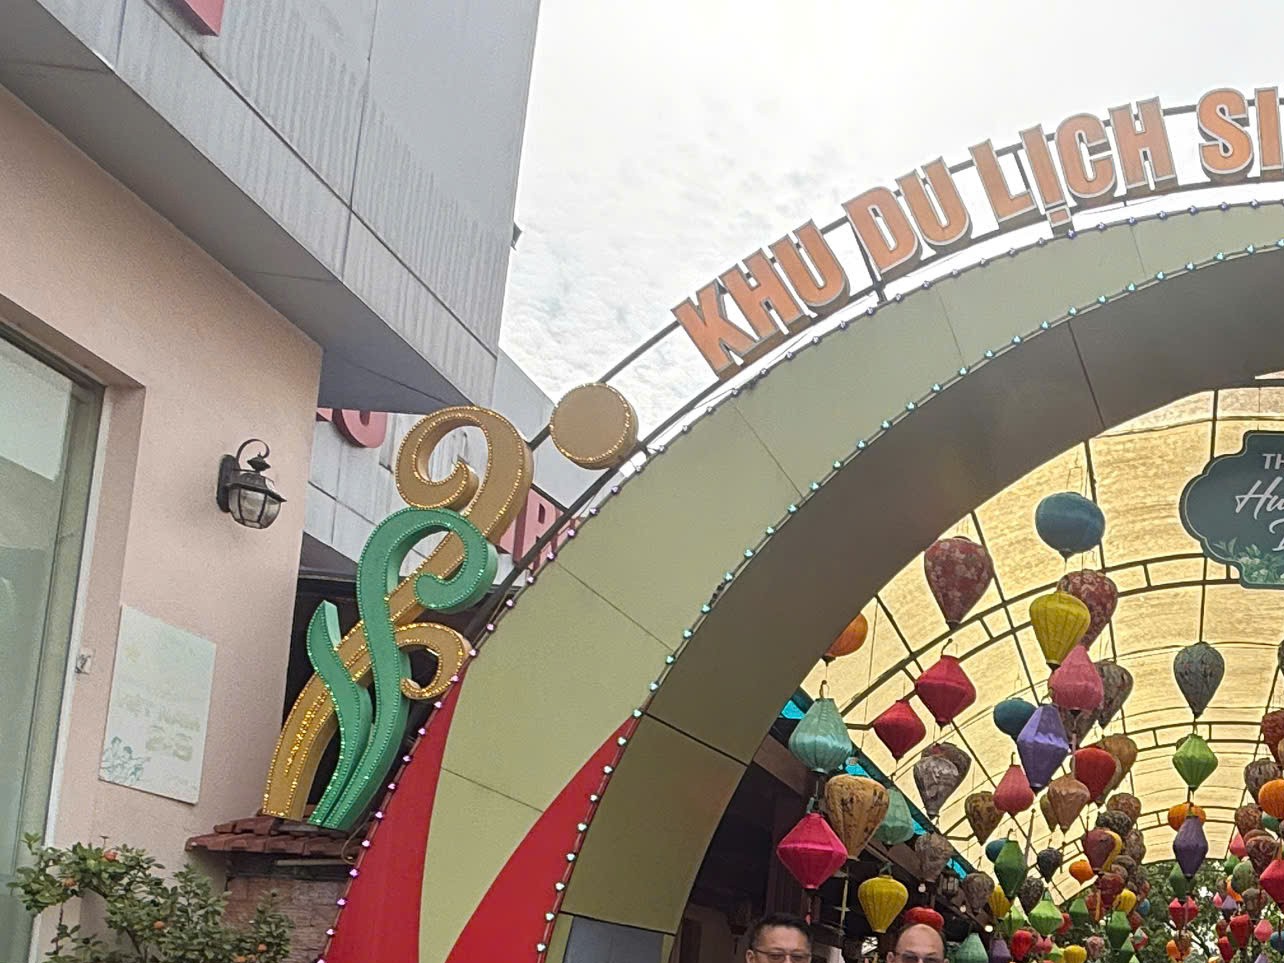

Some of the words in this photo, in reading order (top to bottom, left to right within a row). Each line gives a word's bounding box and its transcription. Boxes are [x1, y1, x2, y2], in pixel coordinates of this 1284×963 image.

[671, 219, 847, 372] KHU
[845, 156, 970, 275] DU
[969, 96, 1178, 226] LỊCH
